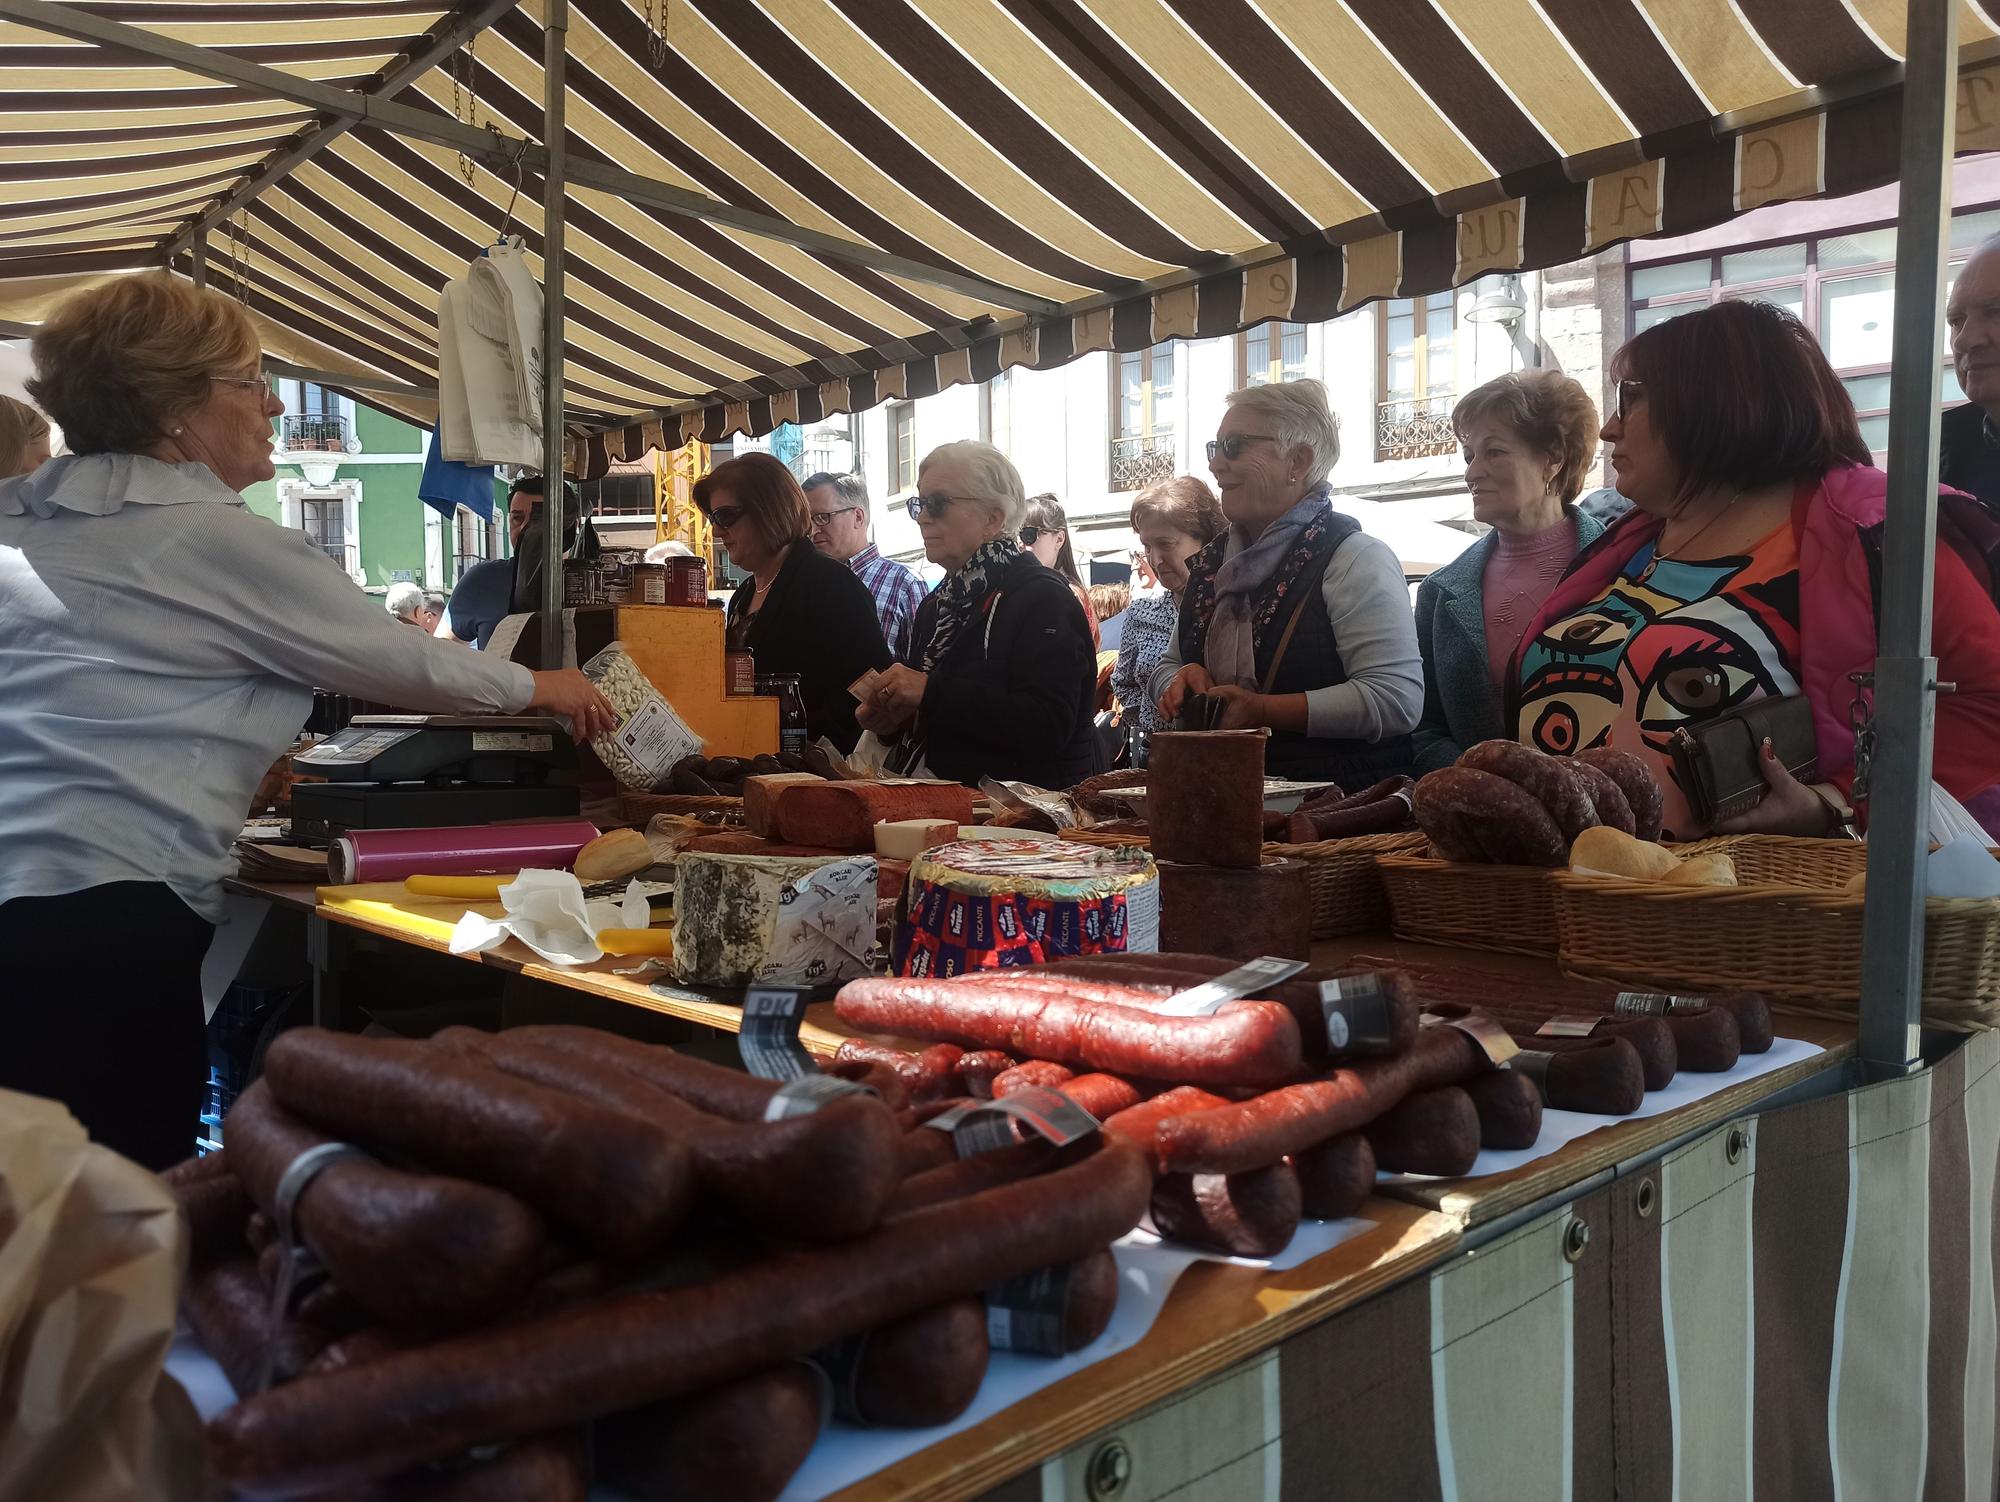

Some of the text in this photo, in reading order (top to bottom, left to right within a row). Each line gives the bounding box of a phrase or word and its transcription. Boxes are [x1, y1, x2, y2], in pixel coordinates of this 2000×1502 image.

[952, 903, 964, 935] Bergader
[1004, 905, 1016, 937] Bergader
[755, 996, 793, 1017] PK
